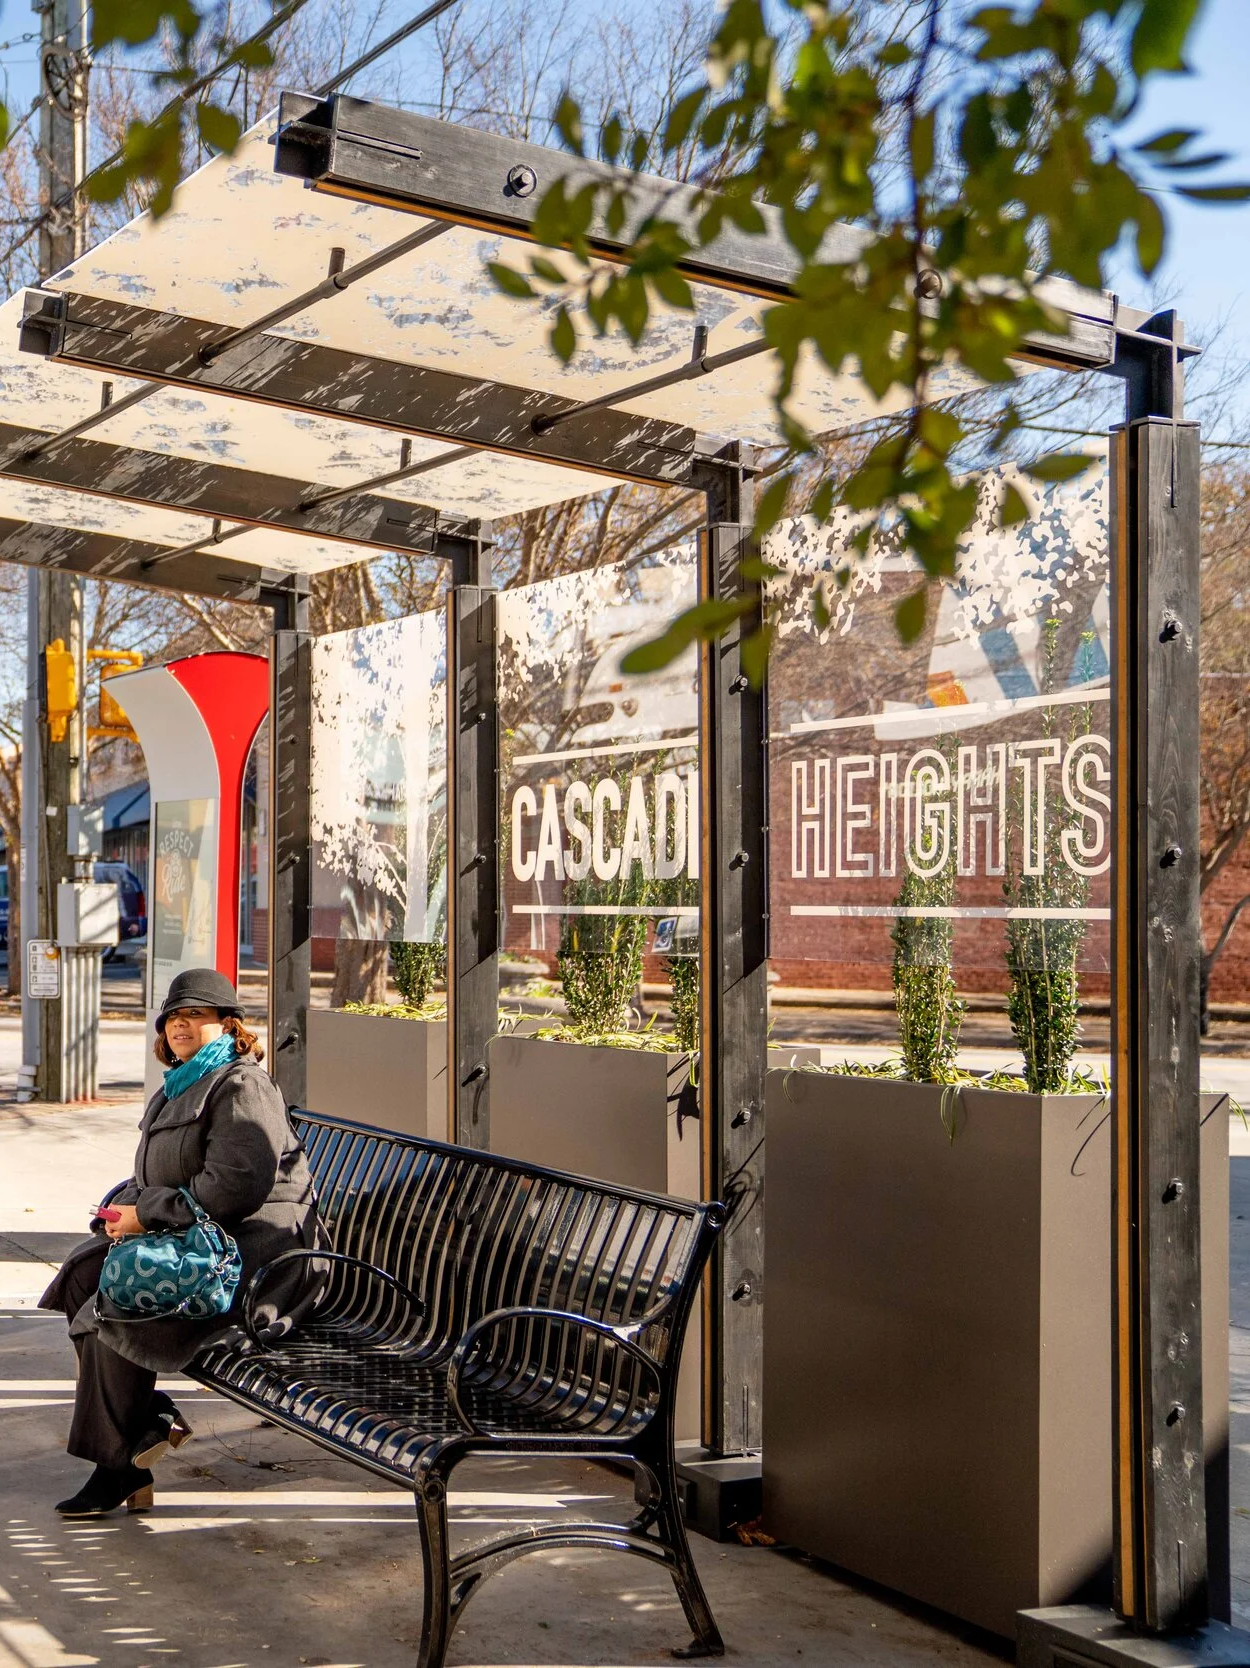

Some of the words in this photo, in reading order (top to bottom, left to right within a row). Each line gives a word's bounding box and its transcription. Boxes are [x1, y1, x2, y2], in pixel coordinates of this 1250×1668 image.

[511, 770, 699, 881] CASCAD
[791, 734, 1111, 878] HEIGHTS
[158, 830, 194, 858] RESPECT
[161, 863, 186, 902] Ride
